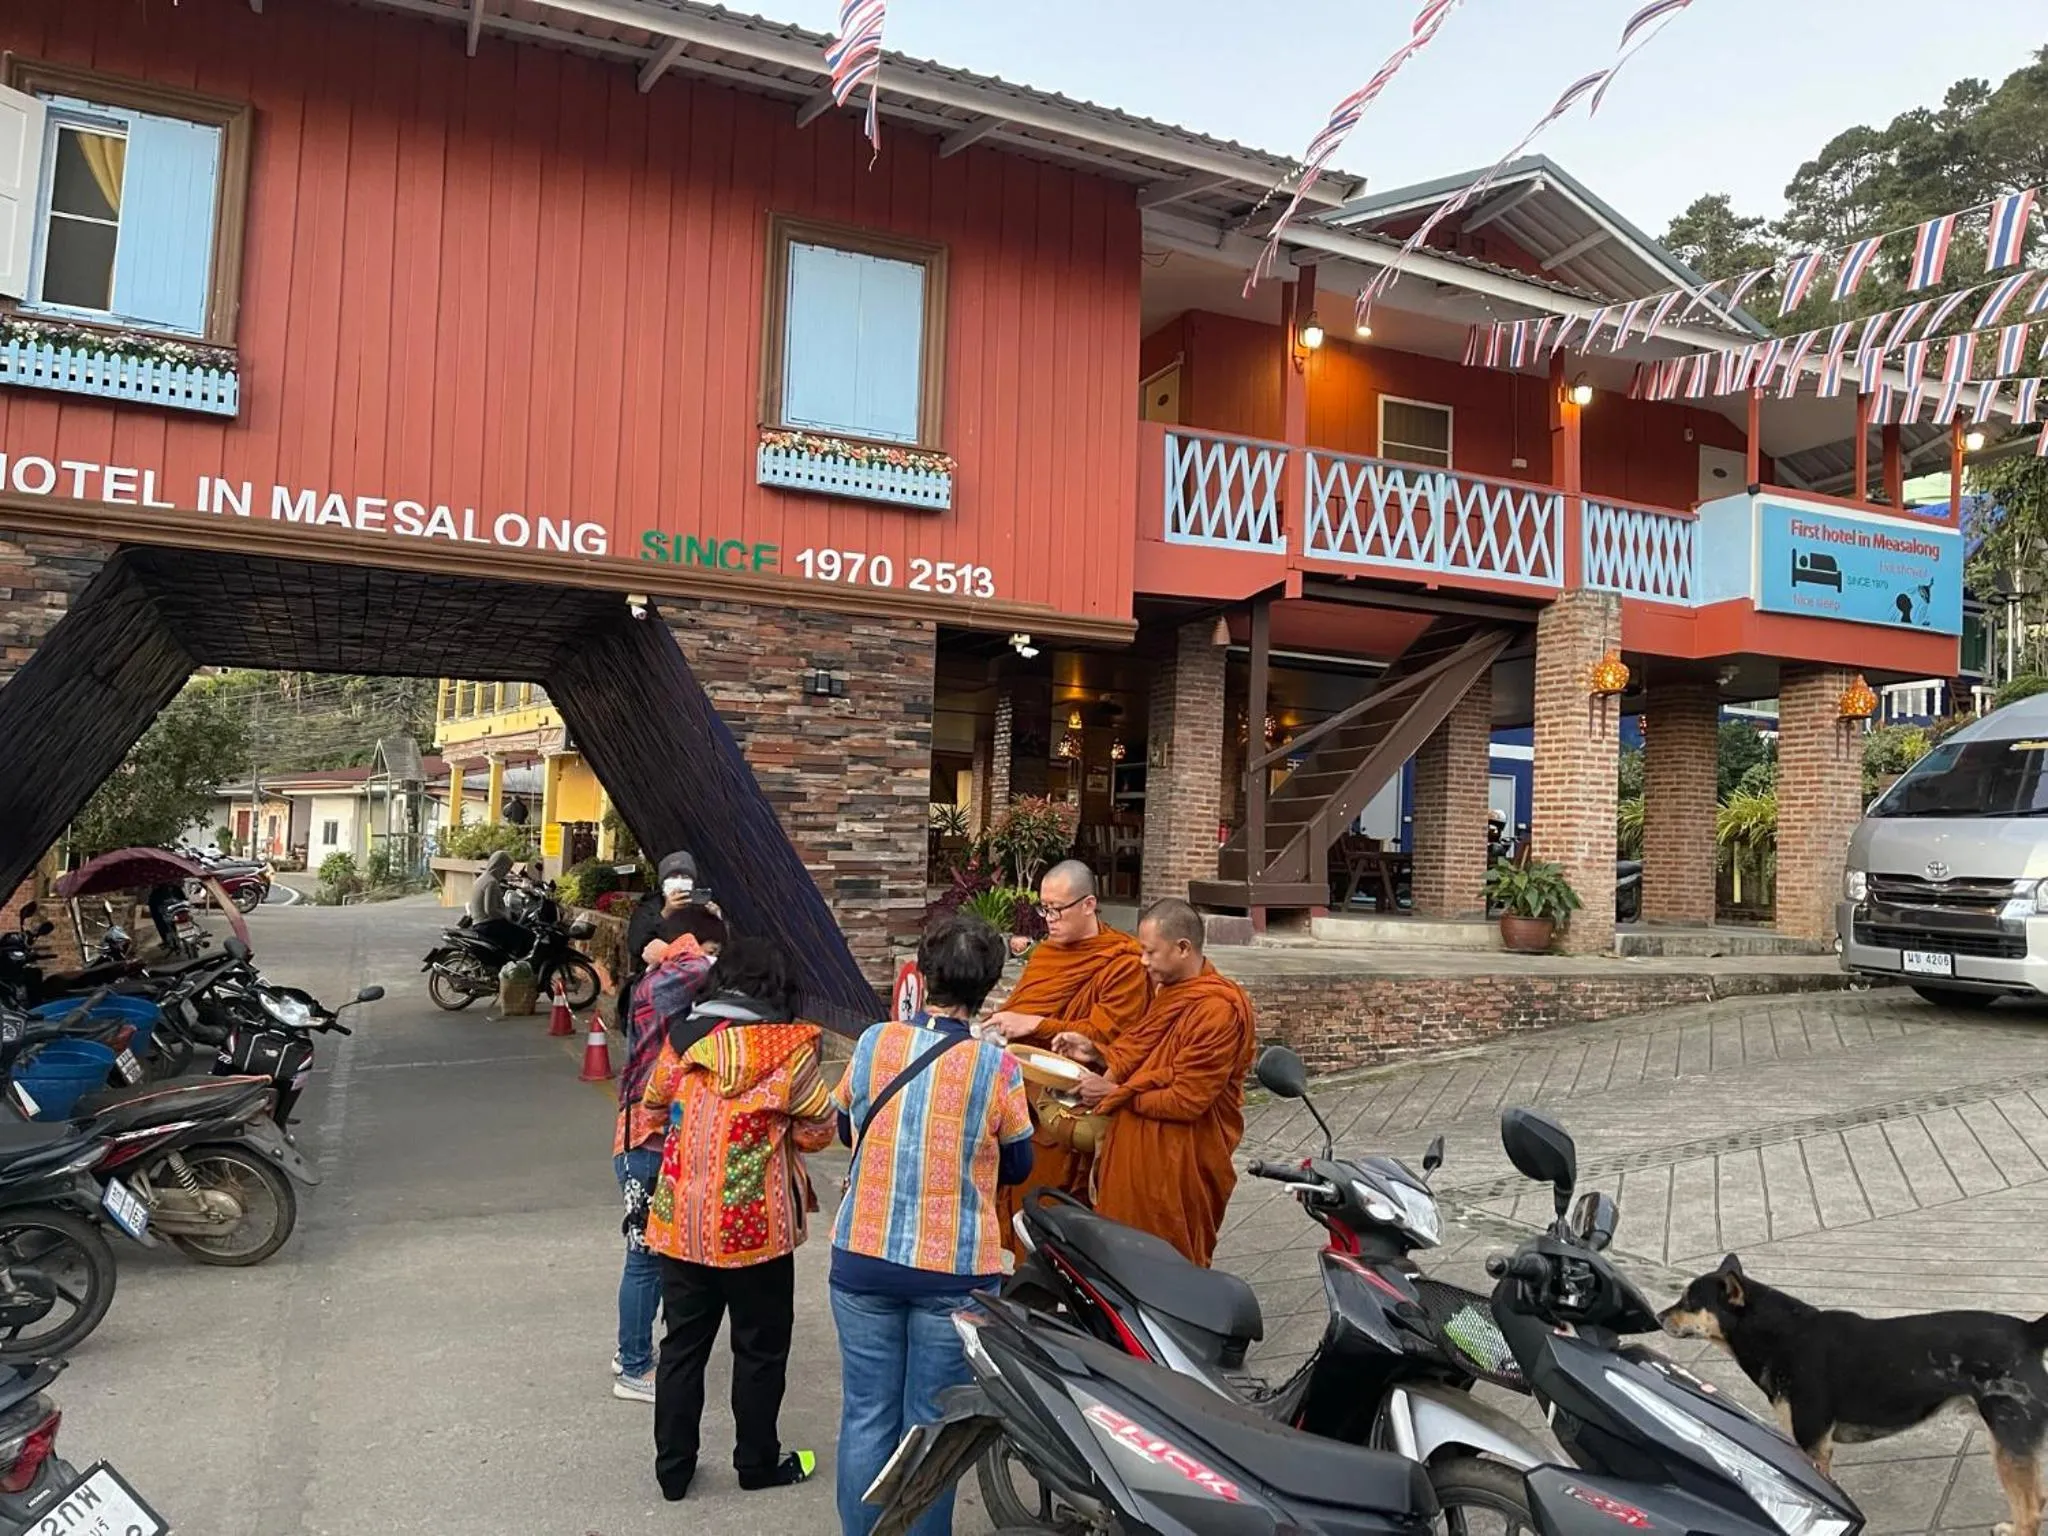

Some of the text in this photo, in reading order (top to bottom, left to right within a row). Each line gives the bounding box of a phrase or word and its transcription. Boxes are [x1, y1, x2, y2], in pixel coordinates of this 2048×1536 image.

[0, 453, 175, 509] OTEL
[196, 476, 252, 517] IN
[270, 485, 607, 555] MAESALONG
[796, 548, 893, 587] 1970
[908, 558, 995, 599] 2513
[1790, 518, 1940, 561] First hotel in Measalong
